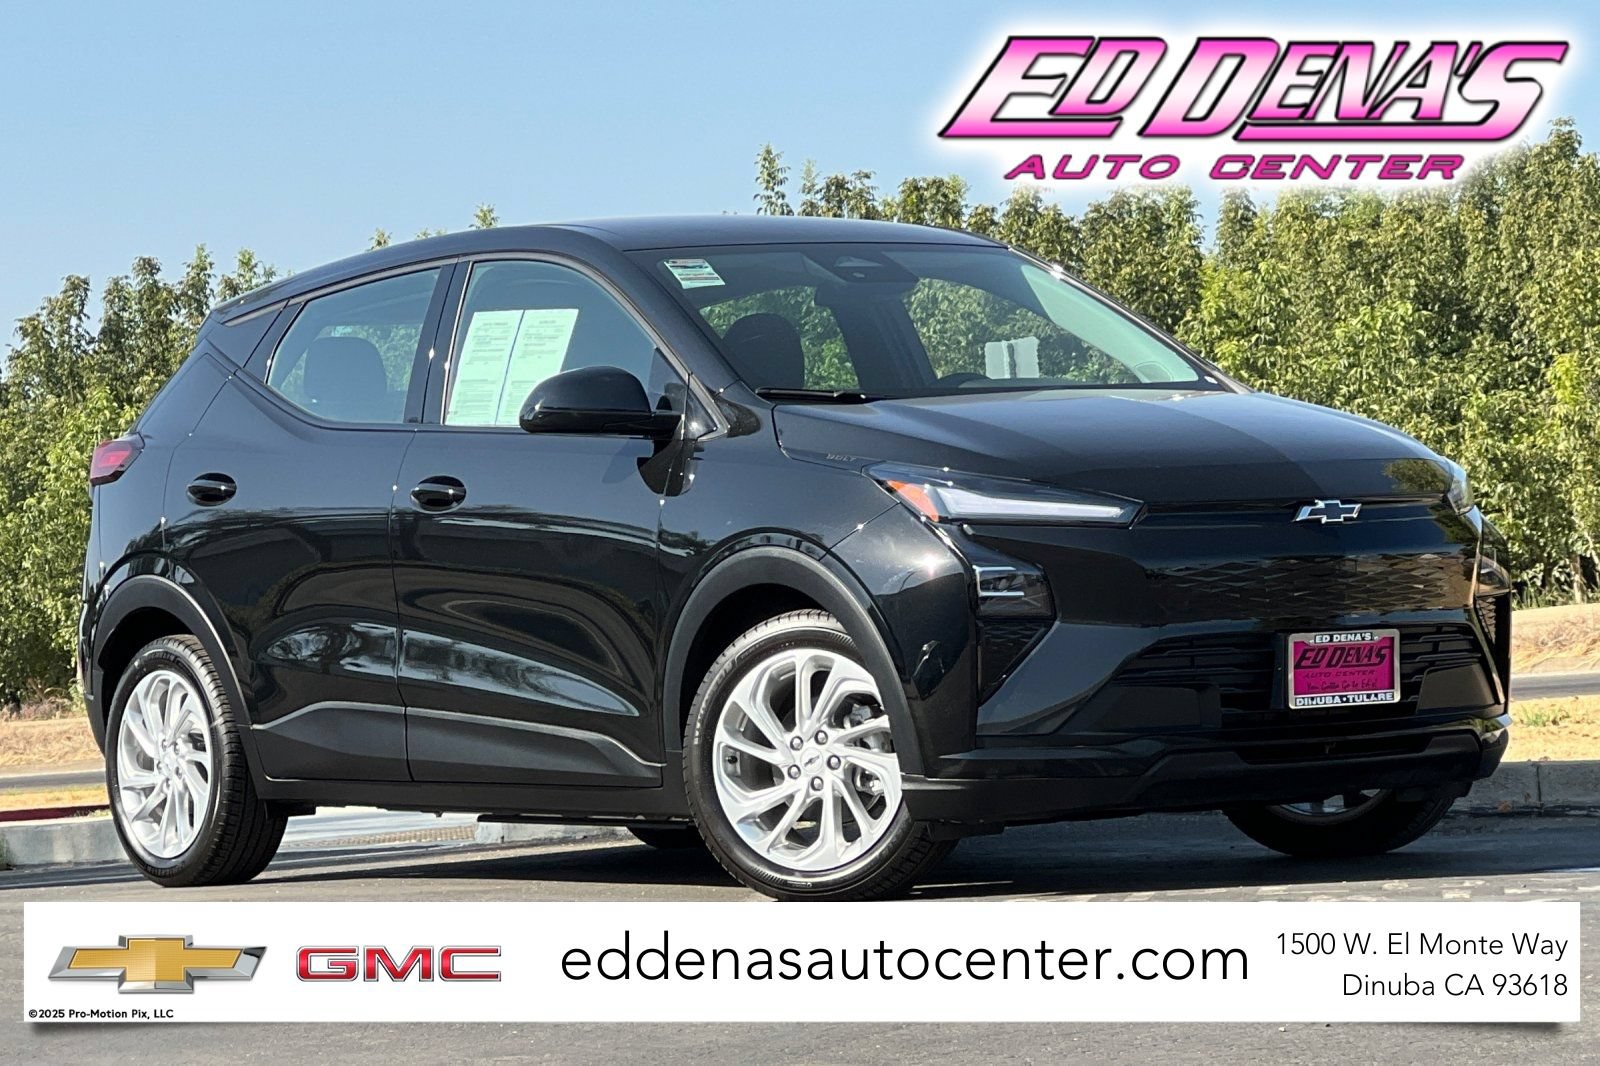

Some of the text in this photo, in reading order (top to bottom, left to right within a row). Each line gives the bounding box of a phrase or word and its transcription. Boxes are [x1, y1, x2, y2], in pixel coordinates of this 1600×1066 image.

[1315, 632, 1372, 643] ED DENA'S
[1294, 647, 1329, 670] ED
[1304, 669, 1376, 679] AUTO CENTER
